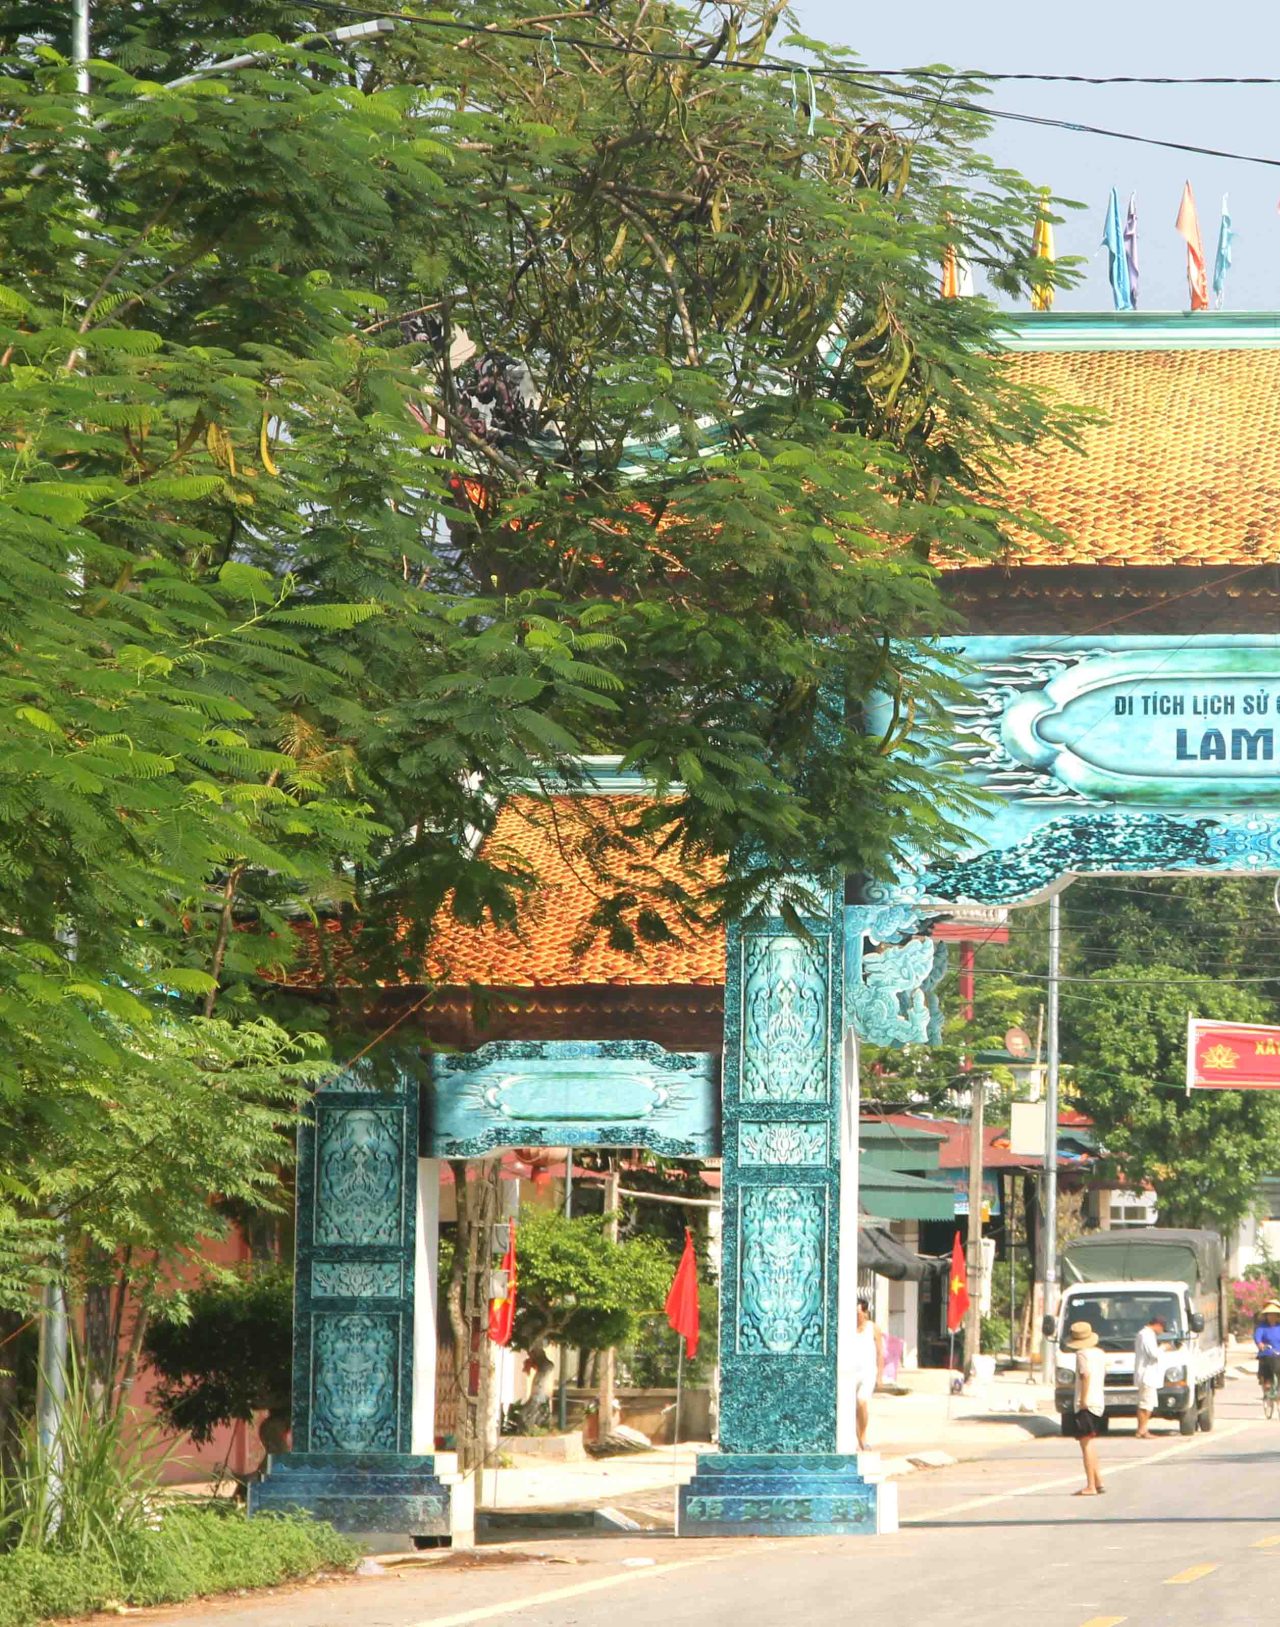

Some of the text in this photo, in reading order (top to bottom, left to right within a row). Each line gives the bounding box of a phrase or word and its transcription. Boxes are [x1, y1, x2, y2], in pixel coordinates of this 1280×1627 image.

[1141, 691, 1185, 716] TÍCH
[1192, 694, 1235, 720] LỊCH
[1242, 689, 1269, 716] SỬ
[1175, 727, 1274, 761] LAM
